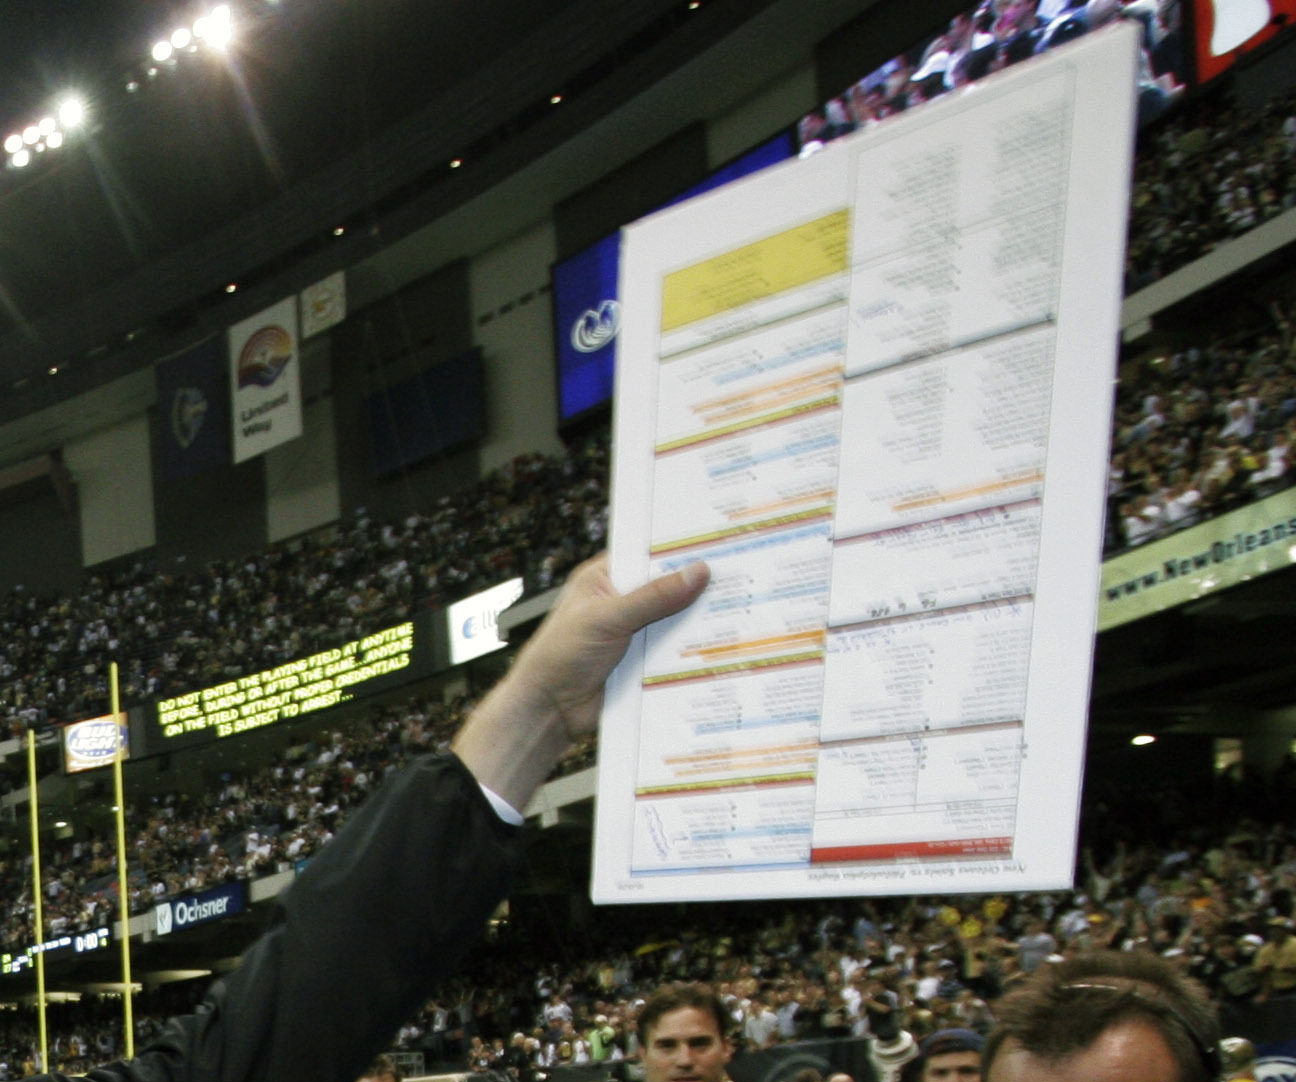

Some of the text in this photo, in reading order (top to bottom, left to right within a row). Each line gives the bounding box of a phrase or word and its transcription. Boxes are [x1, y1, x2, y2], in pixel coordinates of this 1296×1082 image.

[158, 622, 414, 712] DO NOT ENTER THE PLAYING FIELD AT ANYTIME
[204, 691, 246, 713] DURING
[247, 686, 264, 701] OR
[263, 675, 299, 696] AFTER
[299, 667, 323, 684] THE
[164, 653, 410, 737] ON THE FIELD WITHOUT PROPER CREDENTIALS
[216, 722, 233, 738] IS
[233, 708, 280, 733] SUBJECT
[281, 703, 299, 718] TO
[174, 894, 230, 926] Ochsner
